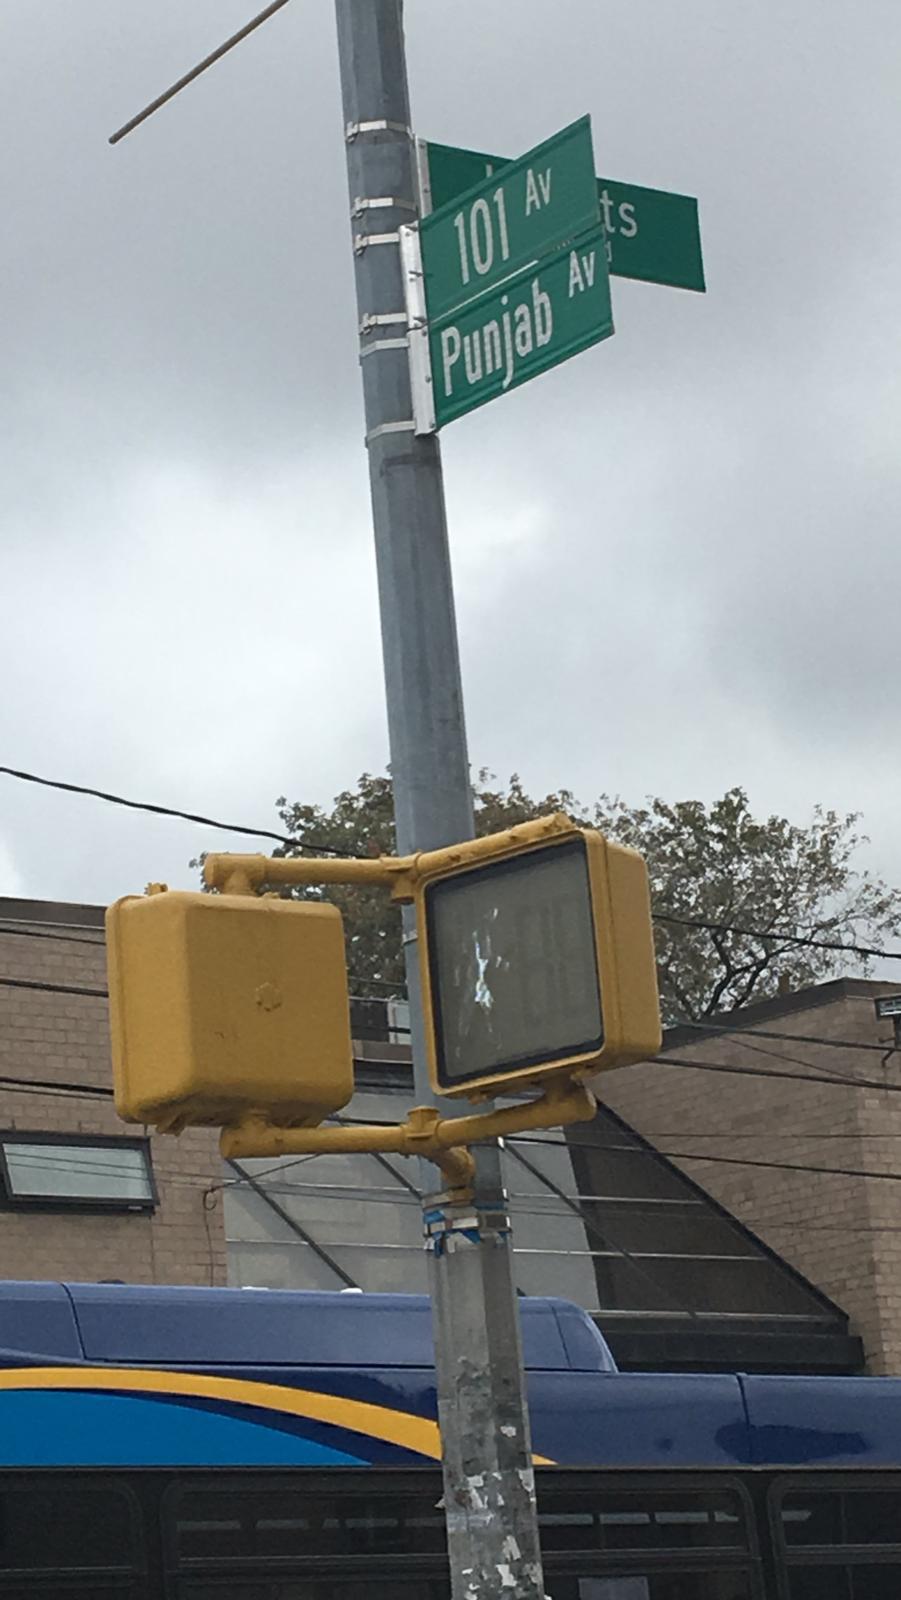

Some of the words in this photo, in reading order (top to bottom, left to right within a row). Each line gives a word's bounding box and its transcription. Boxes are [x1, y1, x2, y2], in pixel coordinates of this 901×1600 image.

[454, 187, 509, 285] 101
[525, 168, 551, 216] Av
[441, 280, 553, 396] Punjab
[568, 249, 595, 297] Av
